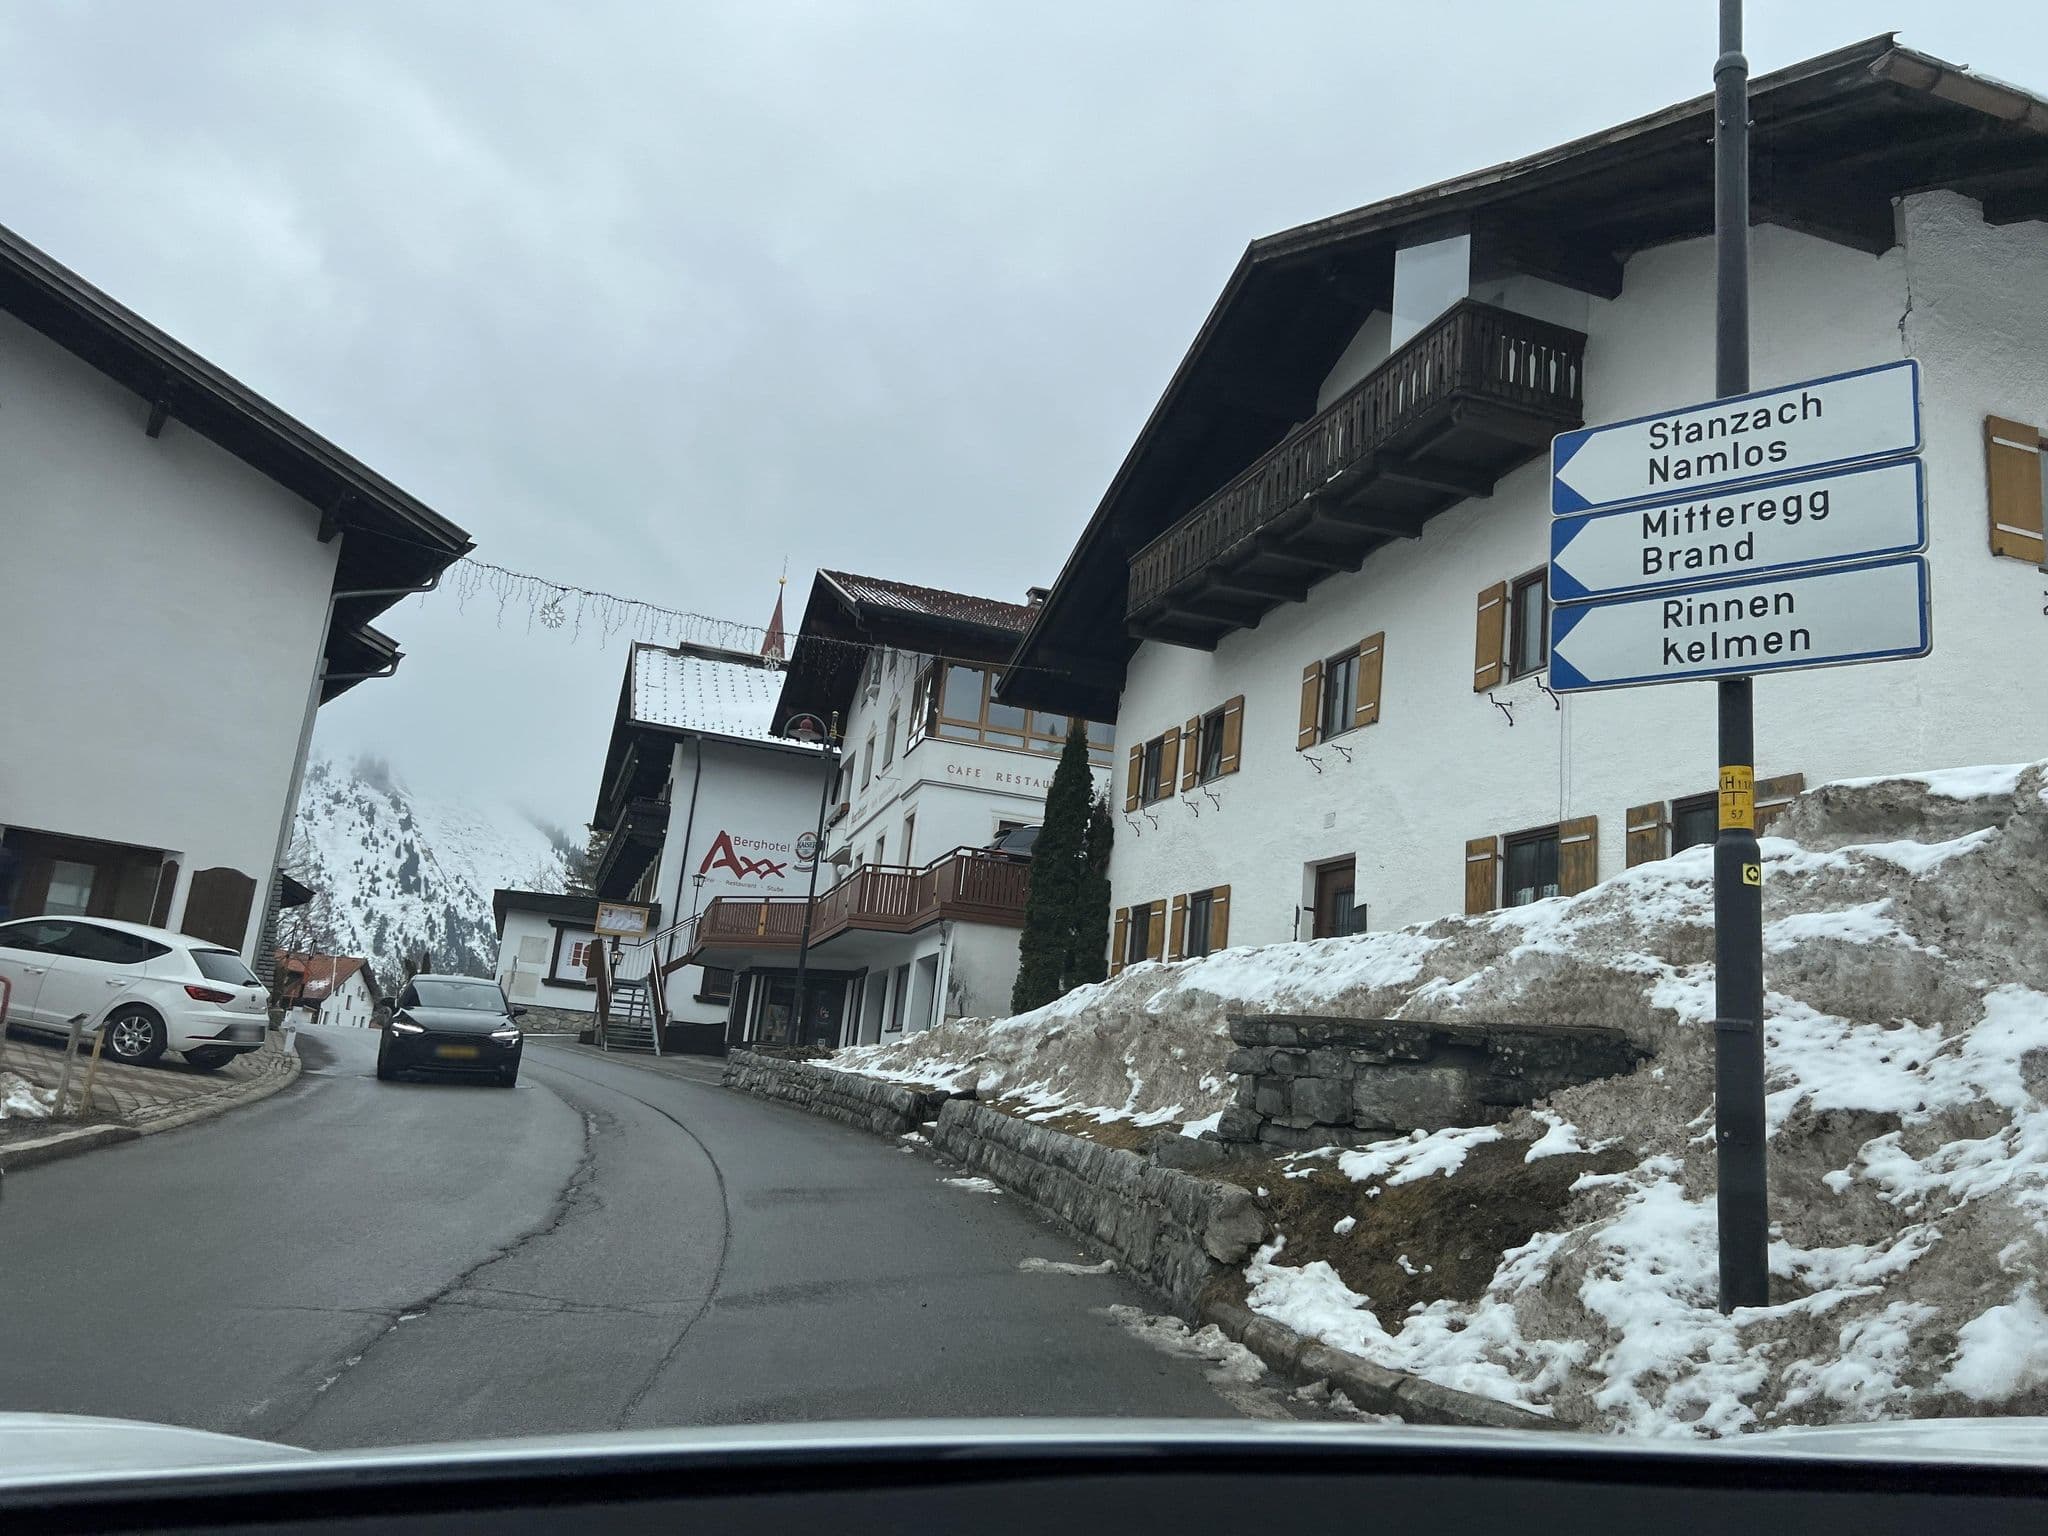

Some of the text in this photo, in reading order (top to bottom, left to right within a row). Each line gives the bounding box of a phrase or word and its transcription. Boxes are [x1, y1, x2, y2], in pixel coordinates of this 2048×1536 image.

[1649, 392, 1822, 450] Stanzach
[1649, 439, 1787, 485] Namlos
[1643, 489, 1830, 539] Mitteregg
[1643, 532, 1754, 575] Brand
[1663, 591, 1795, 628] Rinnen
[947, 764, 1055, 789] CAFE RESTAU
[700, 830, 788, 880] Axx
[733, 836, 790, 853] Berghotel
